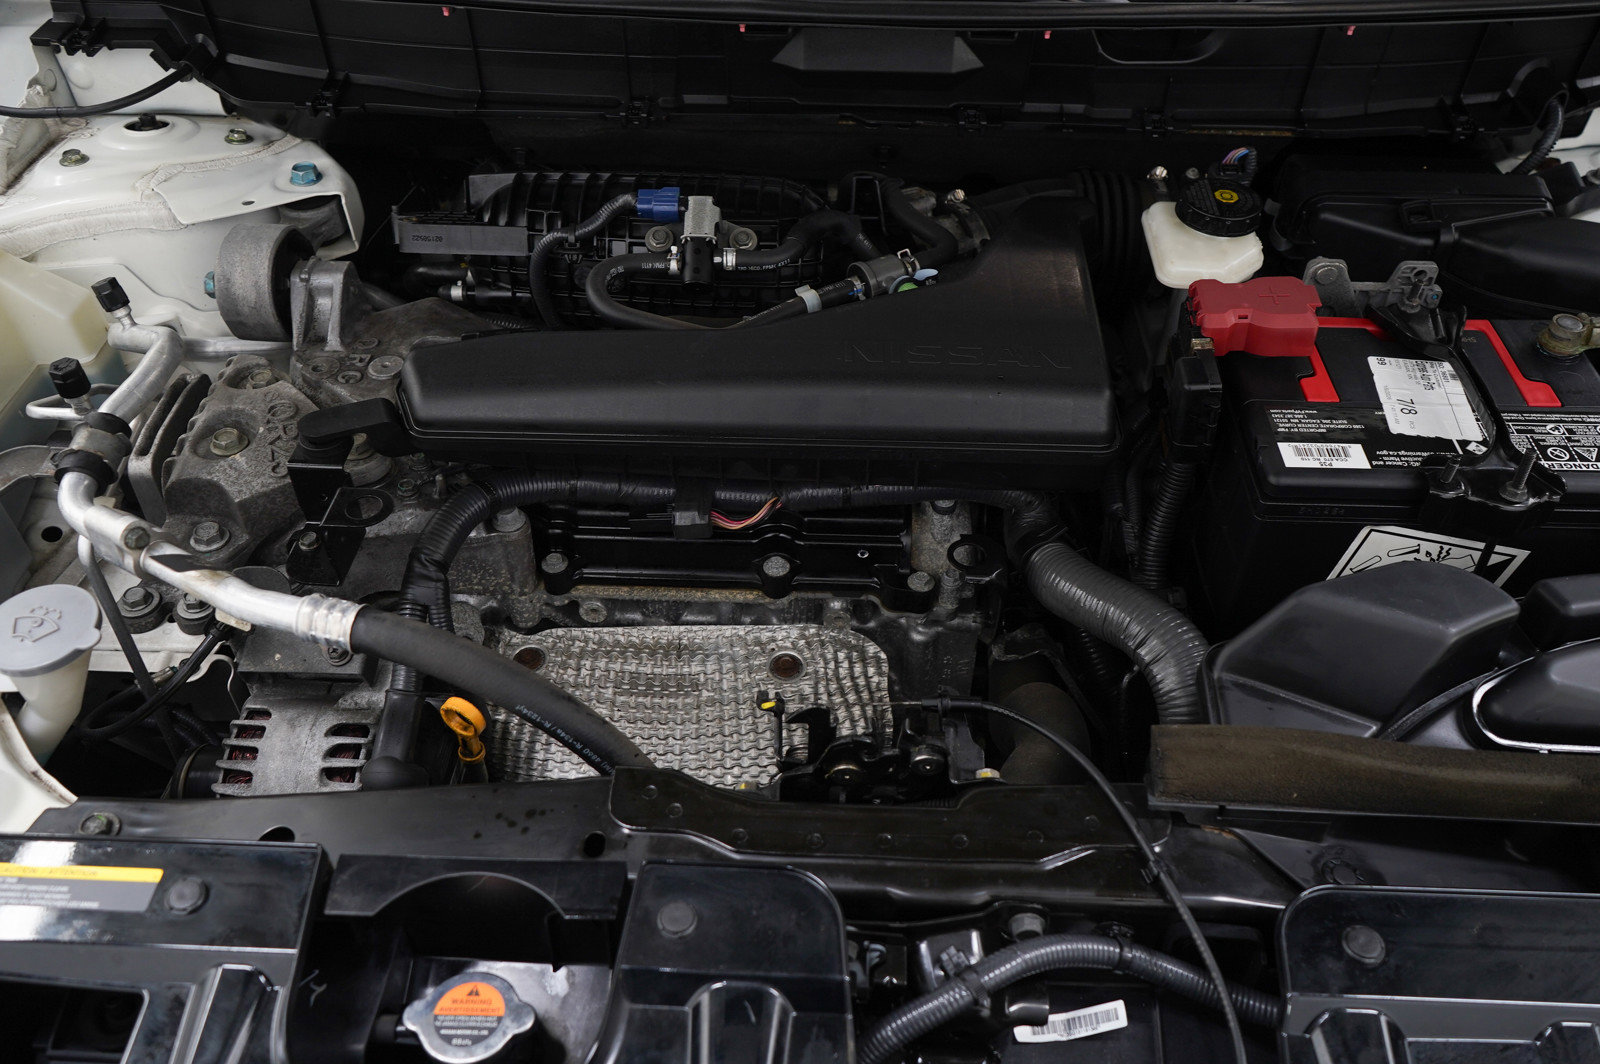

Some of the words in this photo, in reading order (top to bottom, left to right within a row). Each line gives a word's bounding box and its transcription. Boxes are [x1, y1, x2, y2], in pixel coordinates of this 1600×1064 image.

[840, 343, 1072, 369] NISSAN
[1376, 357, 1387, 366] 99
[1396, 398, 1417, 415] 7/8
[515, 704, 552, 729] R-1234yf
[556, 728, 583, 750] R-134a
